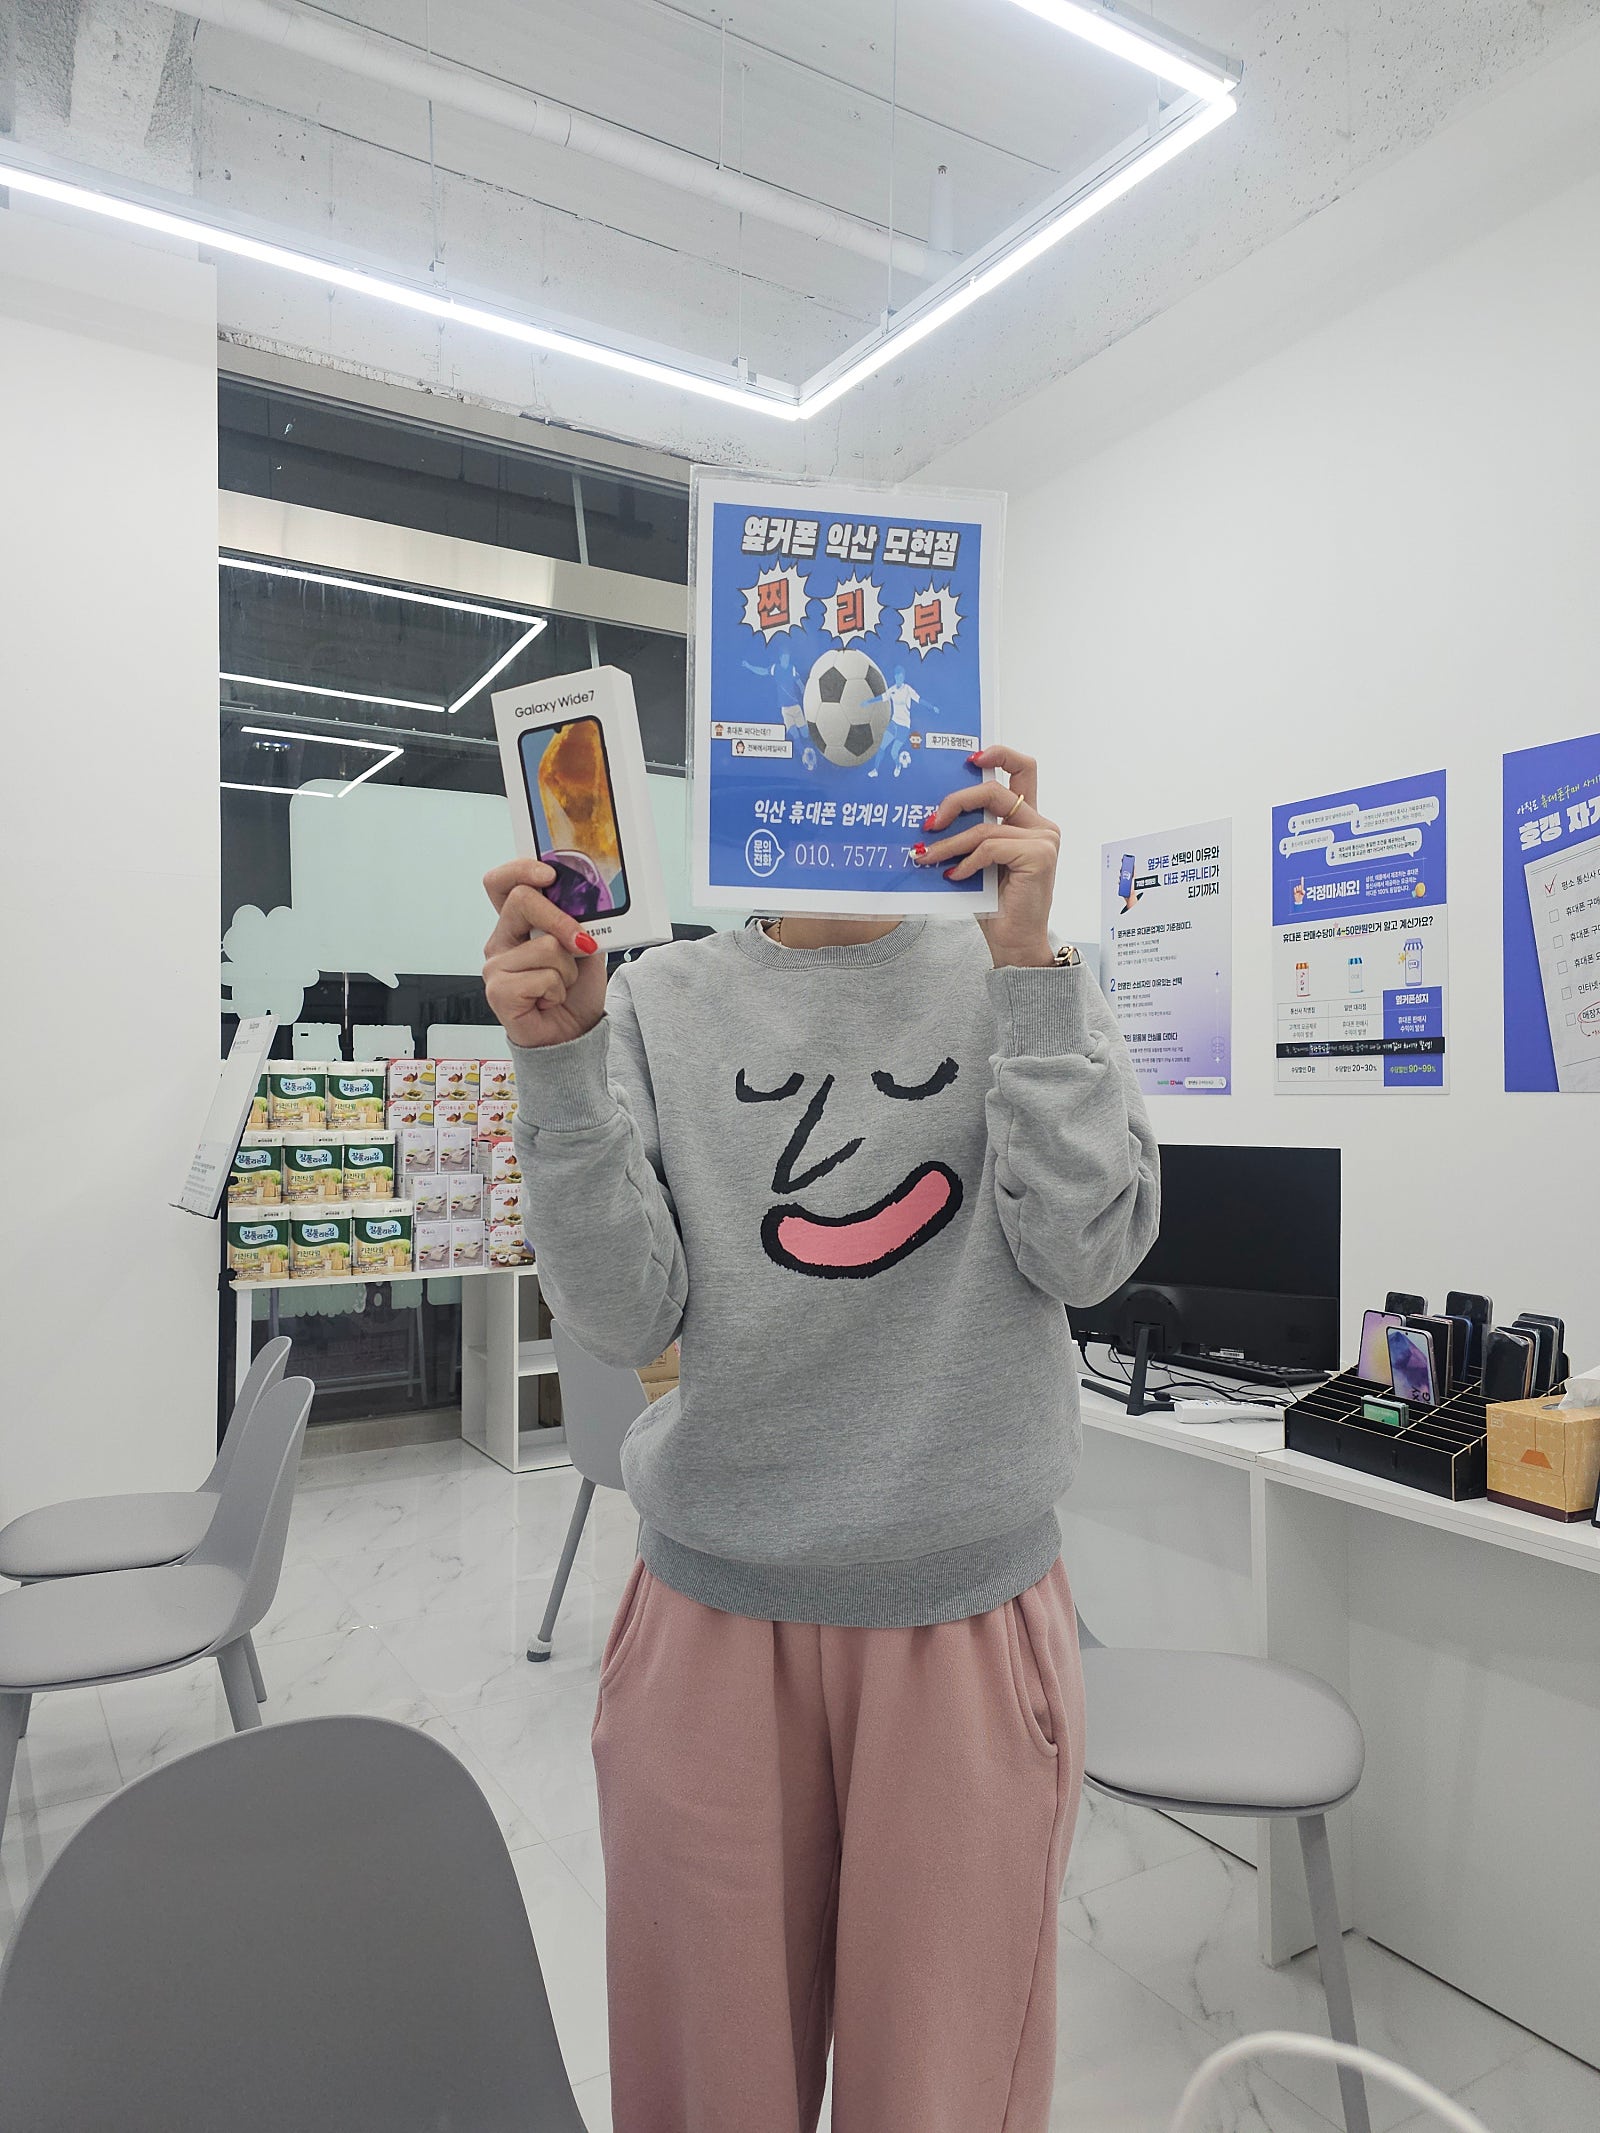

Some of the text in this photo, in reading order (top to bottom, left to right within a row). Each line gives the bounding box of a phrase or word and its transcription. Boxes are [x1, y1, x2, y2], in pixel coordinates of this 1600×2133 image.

[741, 515, 960, 569] 옆커폰 익산 모현점
[757, 577, 790, 630] 찐
[836, 588, 864, 635] 리
[913, 598, 944, 647] 뷰
[514, 690, 595, 718] Galaxy Wide7
[754, 799, 786, 824] 익산
[788, 800, 837, 826] 휴대폰
[842, 802, 889, 827] 업계의
[1518, 811, 1563, 851] 호갱
[1147, 845, 1220, 870] 옆커폰 선택의 이유와
[1163, 872, 1179, 885] 대표
[1180, 864, 1220, 882] 커뮤니티가
[1561, 879, 1575, 891] 평소
[1576, 869, 1596, 885] 통신사
[1188, 881, 1219, 898] 되기까지
[1306, 880, 1360, 901] 걱정마세요!
[1566, 901, 1586, 917] 휴대폰
[1110, 926, 1115, 940] 1
[1283, 932, 1302, 943] 휴대폰
[1383, 920, 1398, 931] 알고
[1399, 915, 1434, 930] 계신가요?
[1570, 927, 1590, 942] 휴대폰
[1574, 954, 1594, 968] 휴대폰
[1110, 978, 1116, 992] 2
